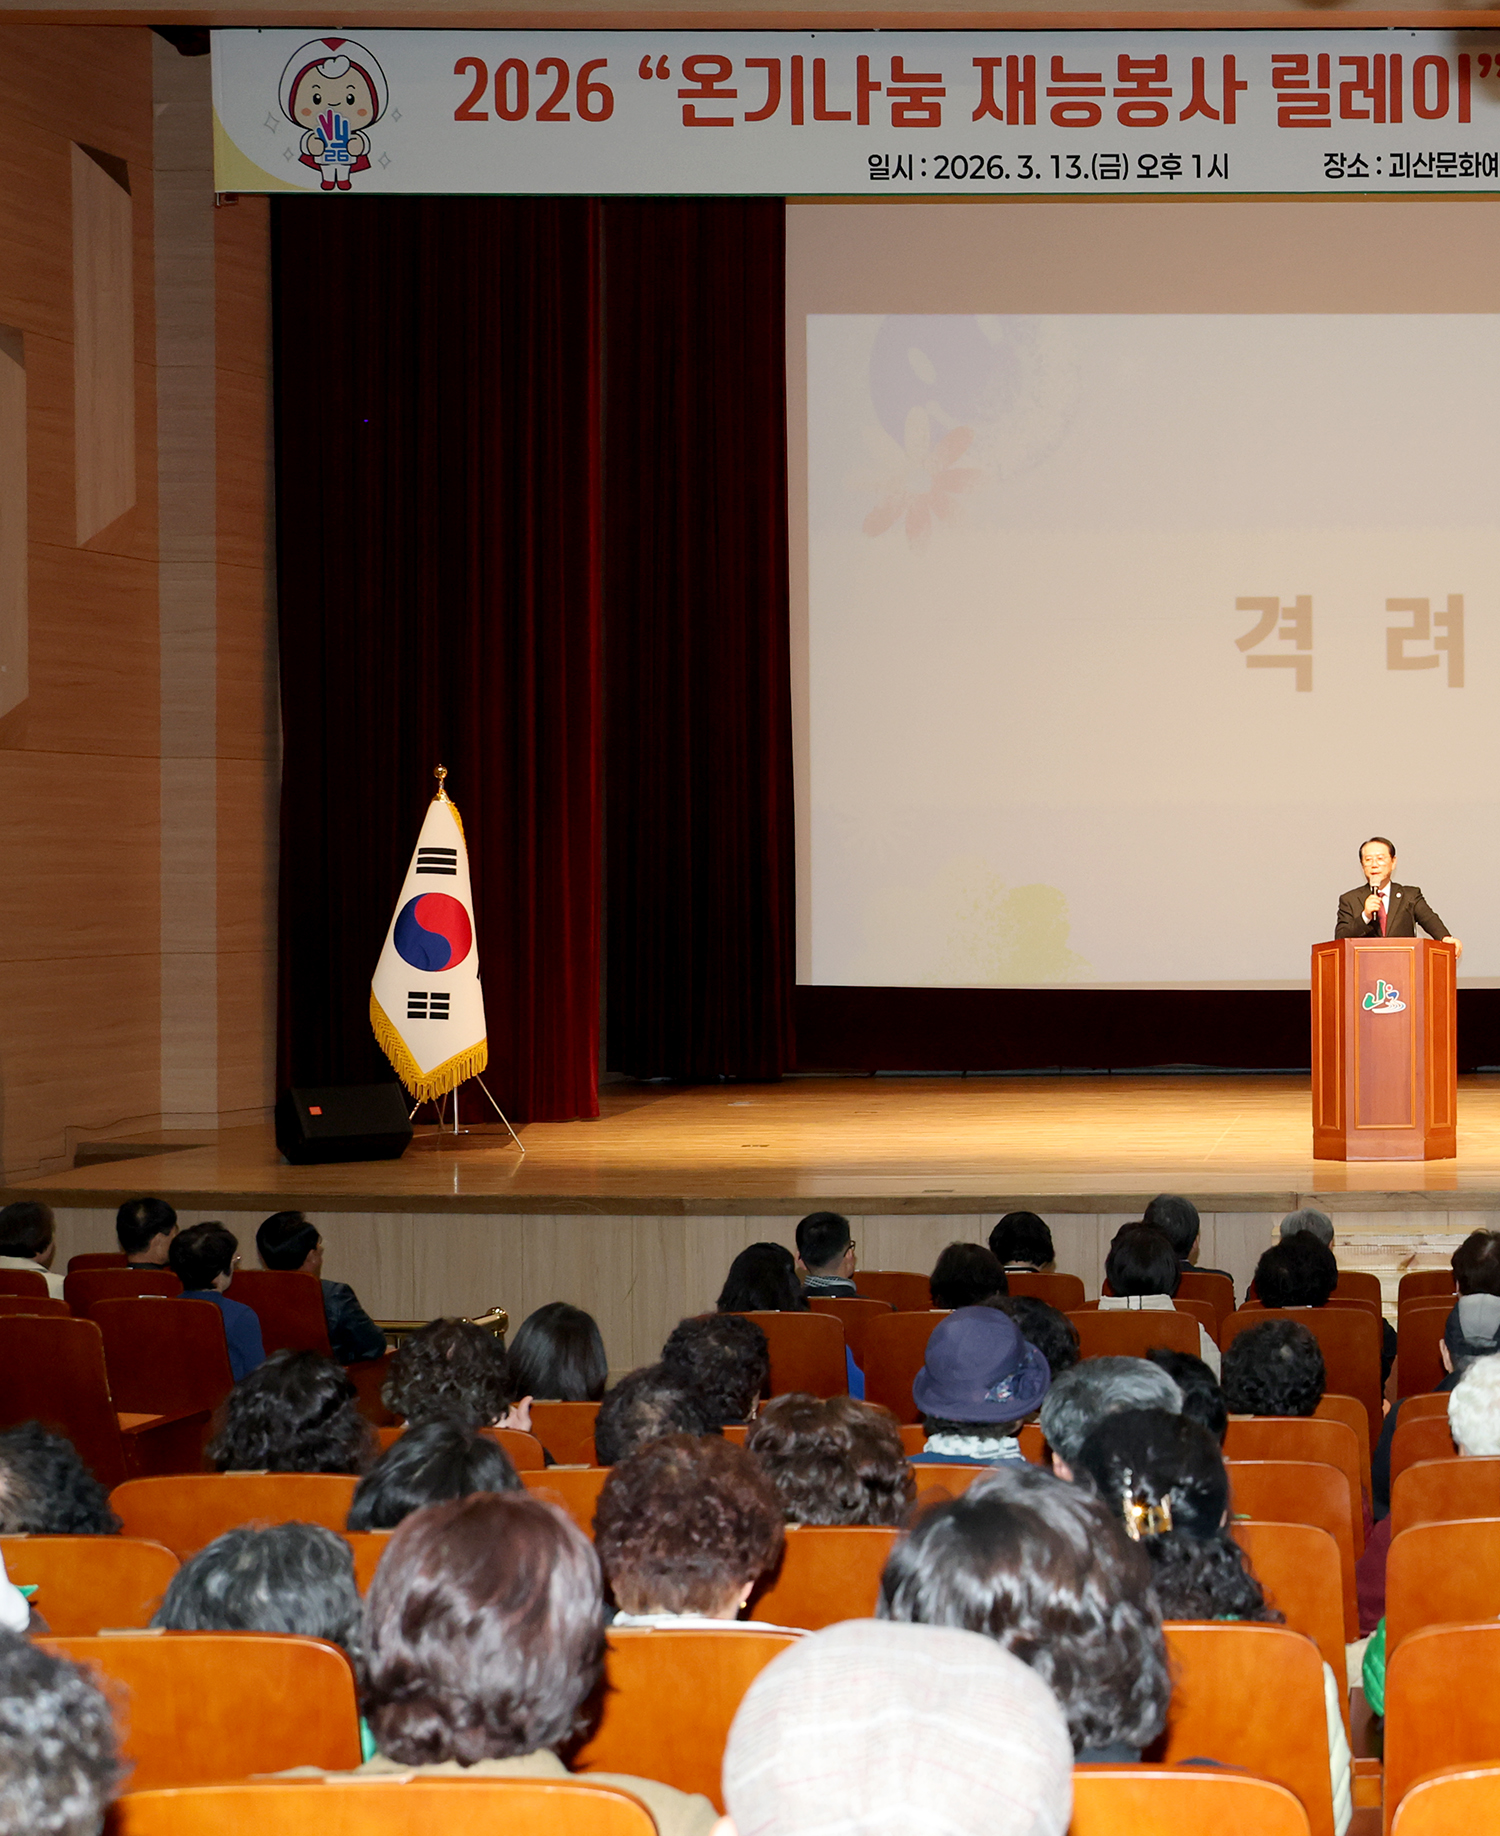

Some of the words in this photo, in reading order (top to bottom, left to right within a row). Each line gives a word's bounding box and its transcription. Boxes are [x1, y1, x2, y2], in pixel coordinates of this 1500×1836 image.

[453, 56, 614, 122] 2026
[638, 54, 946, 128] “온기나눔
[971, 54, 1248, 128] 재능봉사
[324, 149, 349, 162] 26
[1136, 152, 1183, 181] 오후
[1191, 152, 1229, 180] 1시
